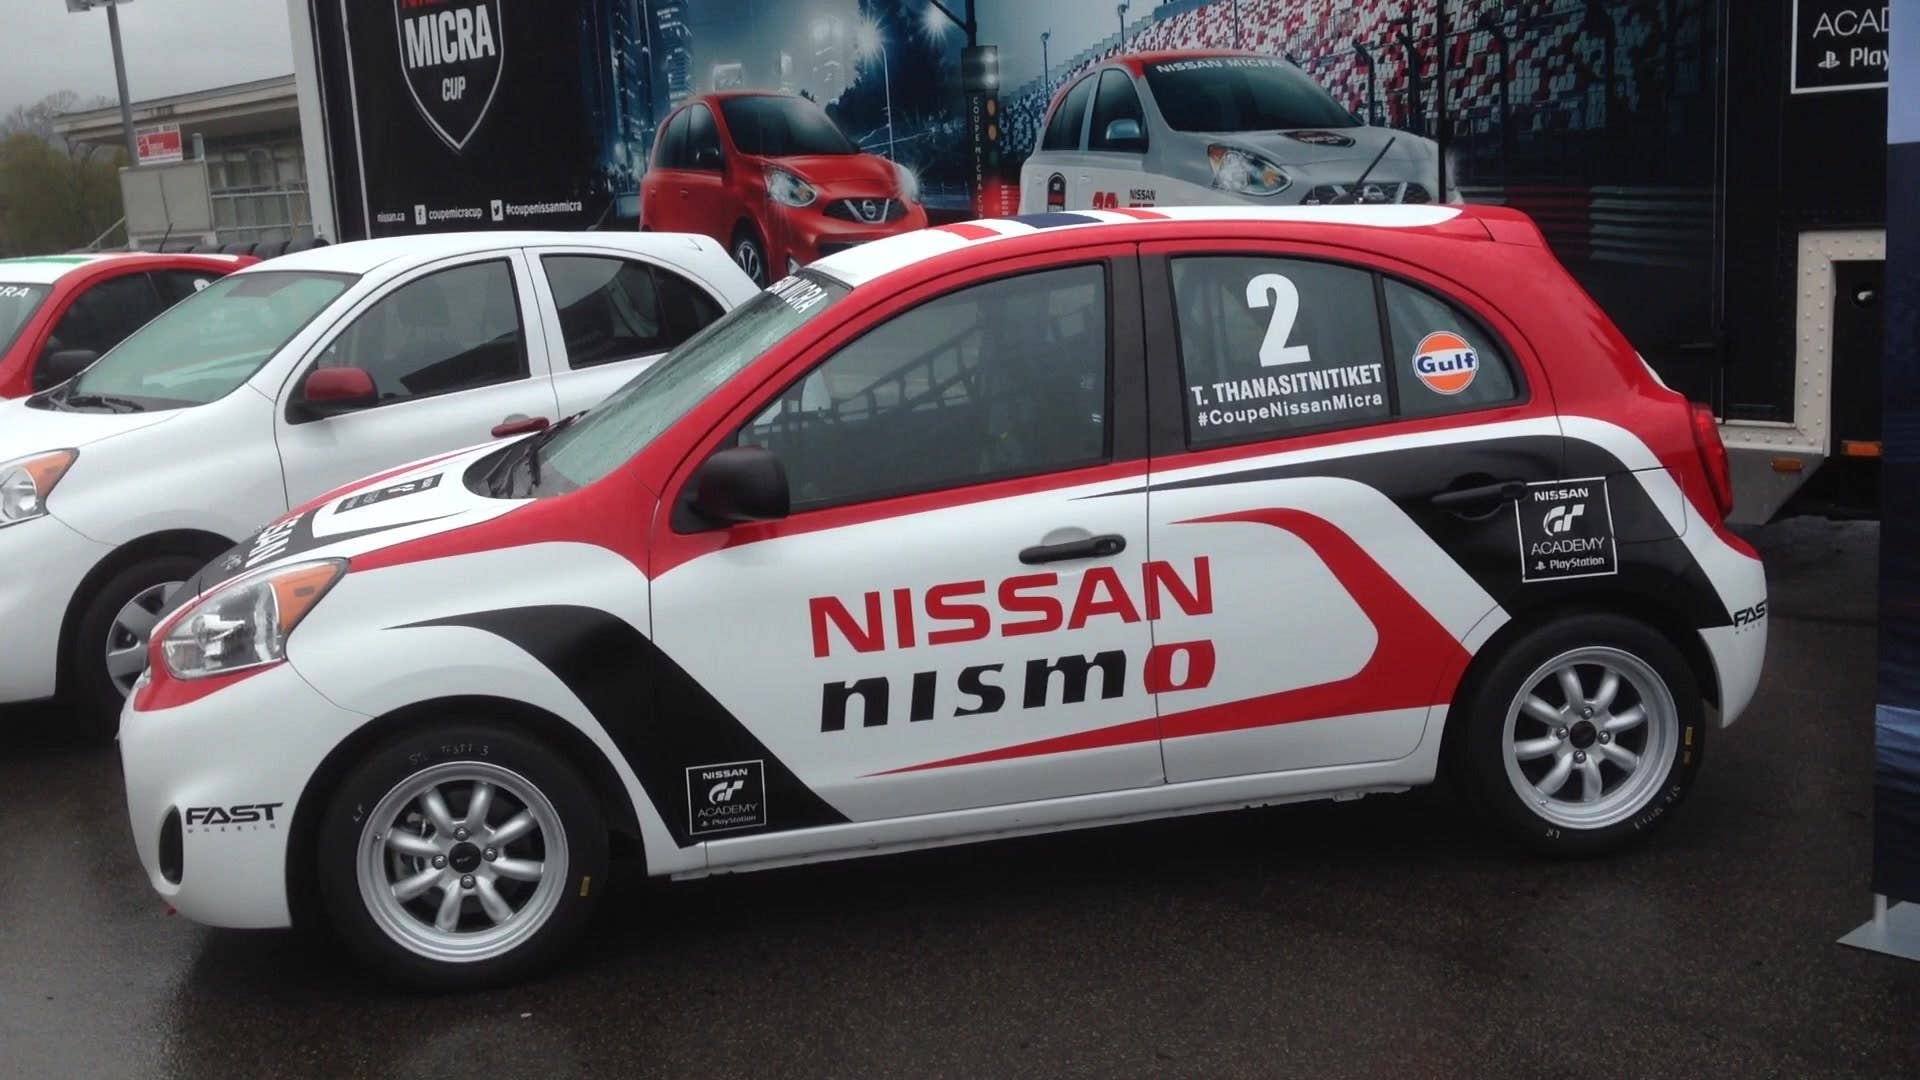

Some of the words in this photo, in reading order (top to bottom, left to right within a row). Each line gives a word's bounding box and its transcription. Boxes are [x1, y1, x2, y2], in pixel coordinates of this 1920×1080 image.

[404, 4, 496, 69] MICRA
[1156, 60, 1223, 73] NISSAN
[442, 76, 466, 102] CUP
[1129, 189, 1156, 201] NISSAN
[377, 211, 405, 223] nissan.ca
[428, 207, 483, 221] coupemicracup
[506, 200, 582, 216] #coupenissanmicra
[0, 285, 31, 298] RA
[1246, 273, 1311, 367] 2
[1416, 352, 1476, 374] Gulf
[1191, 385, 1208, 405] T.
[1213, 364, 1382, 402] THANASITNITIKET
[1198, 393, 1382, 427] #CoupeNissanMicra
[1534, 488, 1589, 501] NISSAN
[1531, 537, 1604, 555] ACADEMY
[1550, 556, 1605, 570] PlayStation
[809, 556, 1213, 658] NISSAN
[1734, 601, 1767, 628] FAS
[821, 640, 1216, 733] nismo
[702, 768, 748, 780] NISSAN
[186, 802, 284, 825] FAST
[698, 802, 758, 818] ACADEMY
